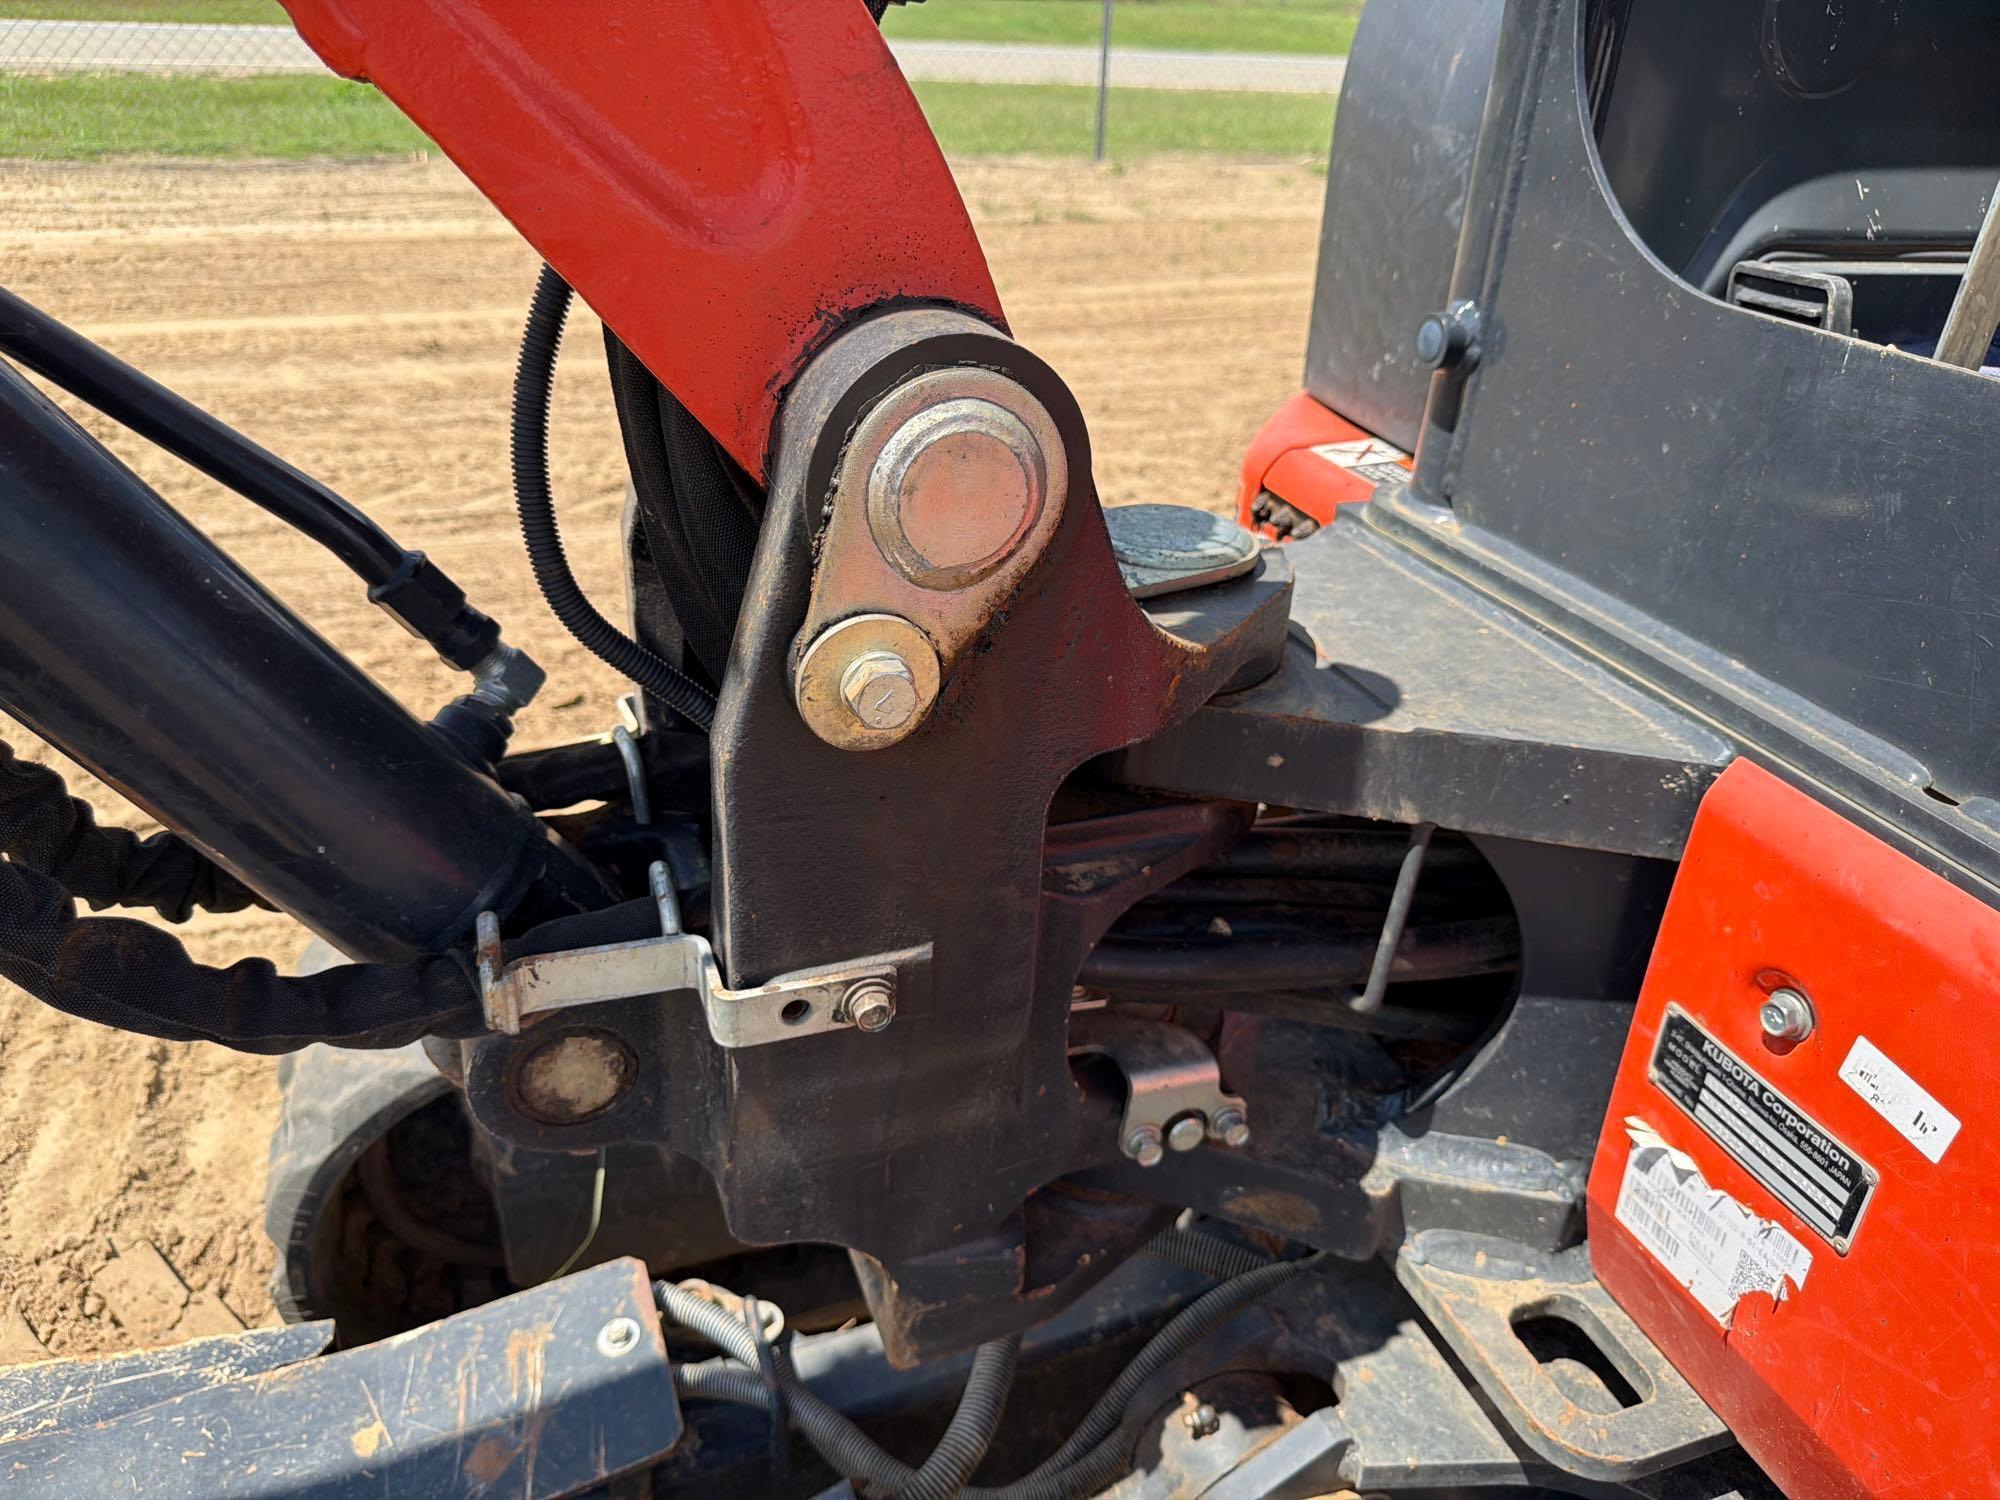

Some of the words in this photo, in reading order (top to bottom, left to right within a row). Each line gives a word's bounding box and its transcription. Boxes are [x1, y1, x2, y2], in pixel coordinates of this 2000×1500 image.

[1667, 1040, 1701, 1076] MODEL
[1702, 1039, 1762, 1098] KUBOTA
[1762, 1090, 1851, 1171] Corporation
[1799, 1139, 1828, 1168] 556-8601
[1828, 1165, 1851, 1188] JAPAN
